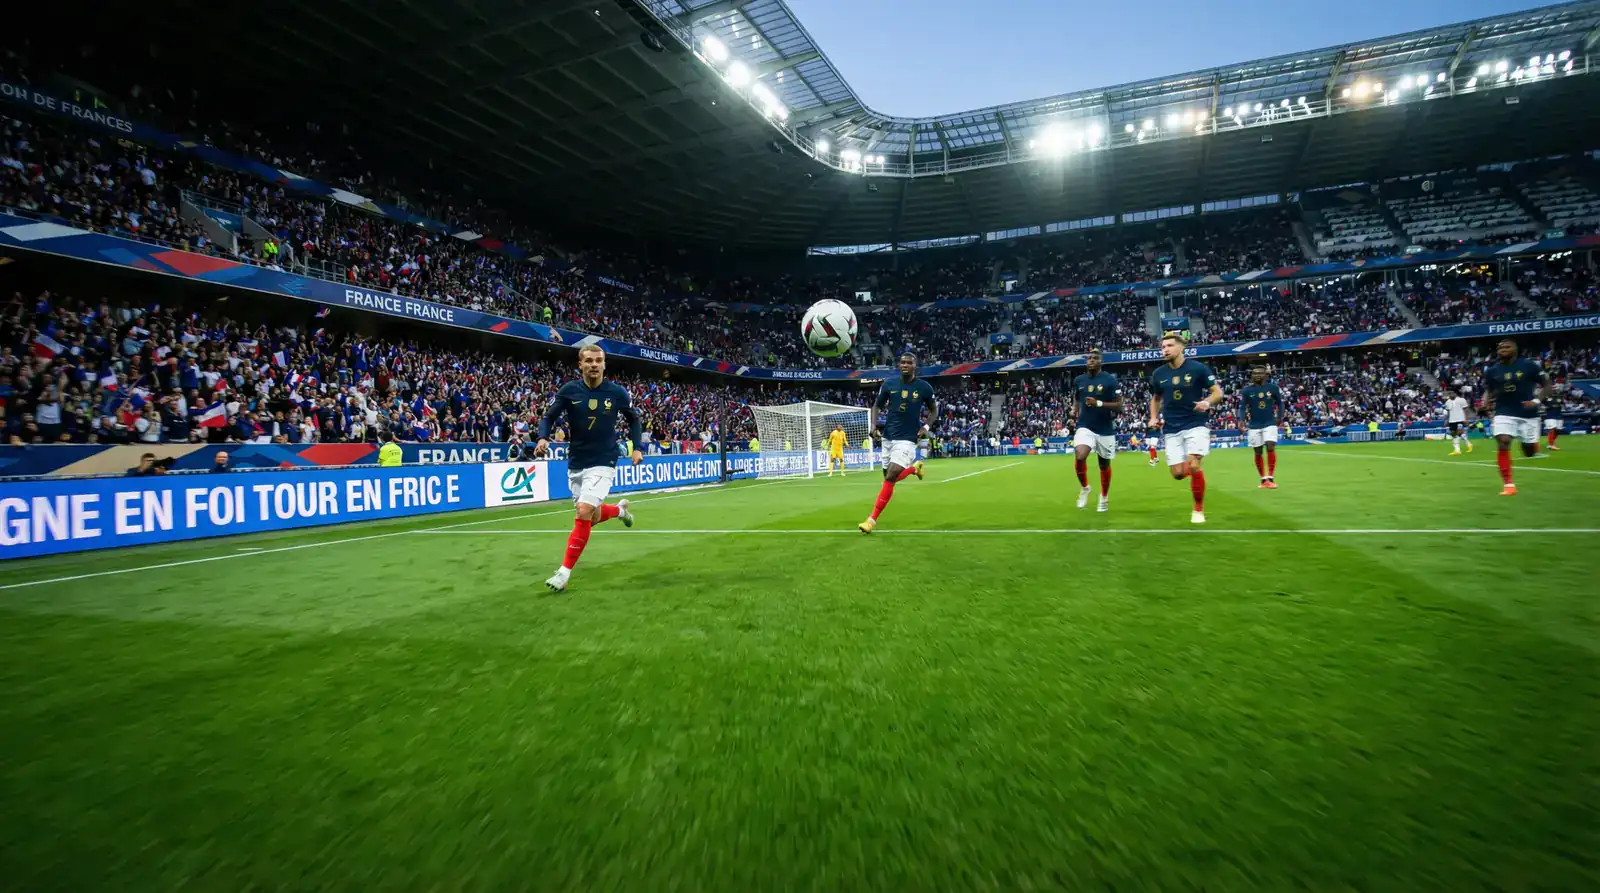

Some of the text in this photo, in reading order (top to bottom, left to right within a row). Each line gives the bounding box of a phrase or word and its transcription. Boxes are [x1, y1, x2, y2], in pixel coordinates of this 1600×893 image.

[33, 92, 56, 110] DE
[61, 101, 133, 133] FRANCES
[345, 289, 454, 322] FRANCE FRANCE
[1489, 321, 1541, 334] FRANCE
[587, 416, 597, 430] 7
[418, 447, 502, 464] FRANCE
[657, 462, 672, 483] ON
[114, 489, 174, 535] EN
[185, 485, 245, 528] FOI
[252, 480, 338, 521] TOUR
[346, 478, 382, 512] EN
[389, 475, 442, 509] FRIC
